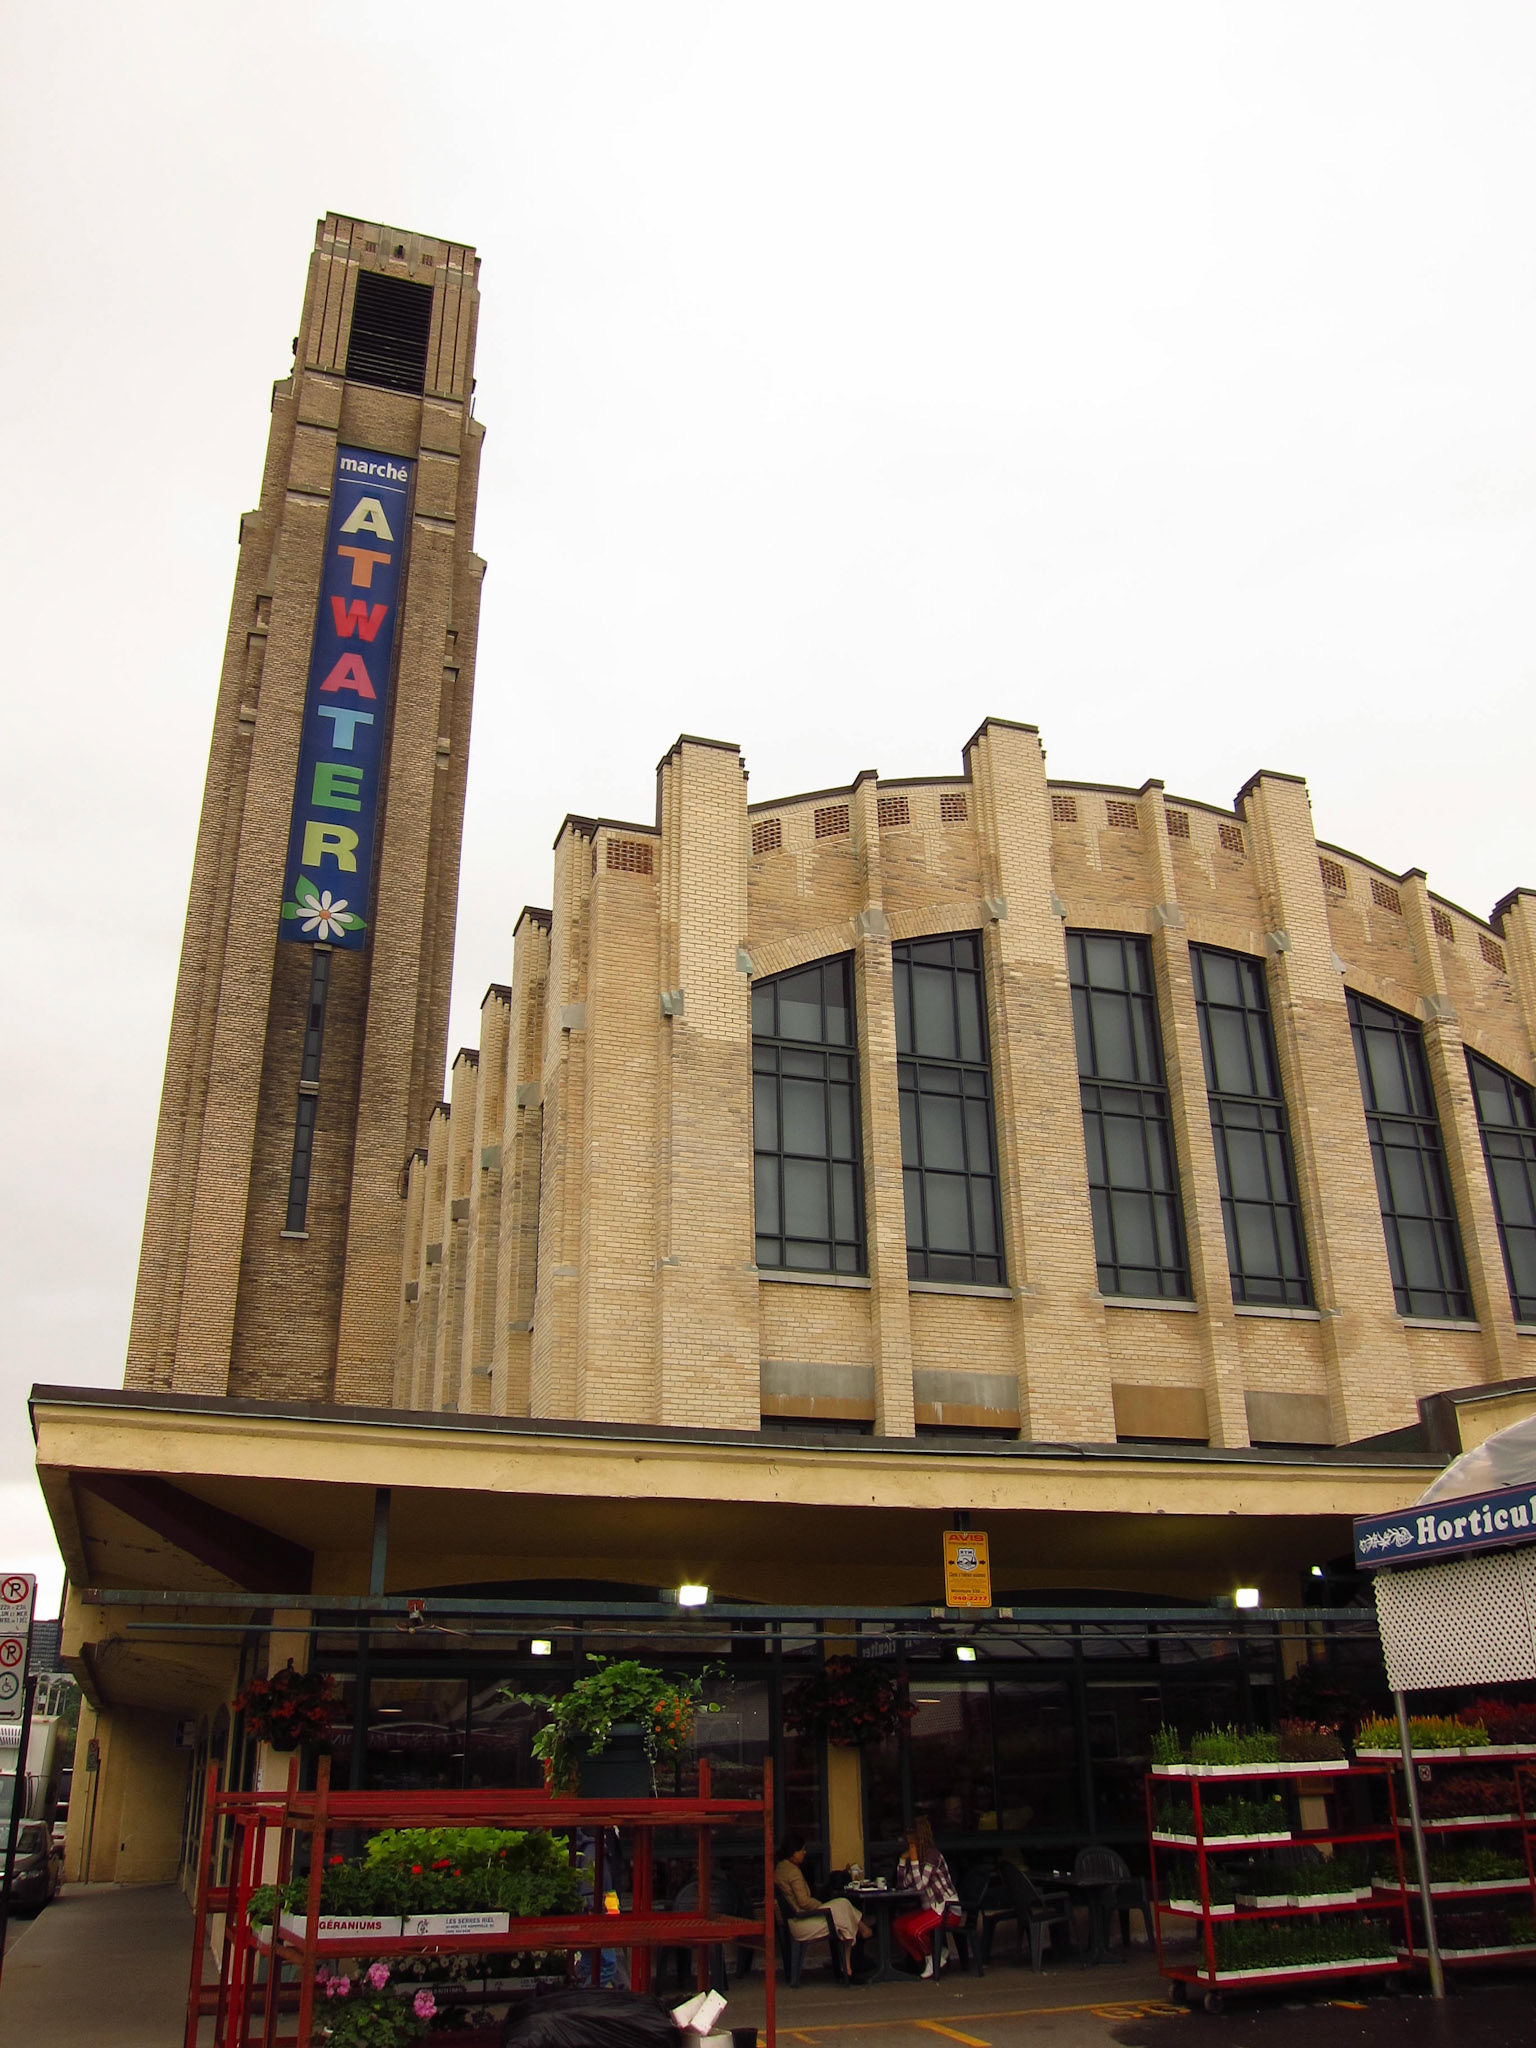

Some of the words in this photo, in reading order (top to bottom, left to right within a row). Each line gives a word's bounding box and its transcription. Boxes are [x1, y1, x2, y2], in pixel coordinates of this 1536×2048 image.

[340, 457, 408, 482] marché
[301, 496, 394, 873] ATWATER
[948, 1534, 985, 1542] AVIS
[319, 1918, 382, 1930] GÉRANIUMS
